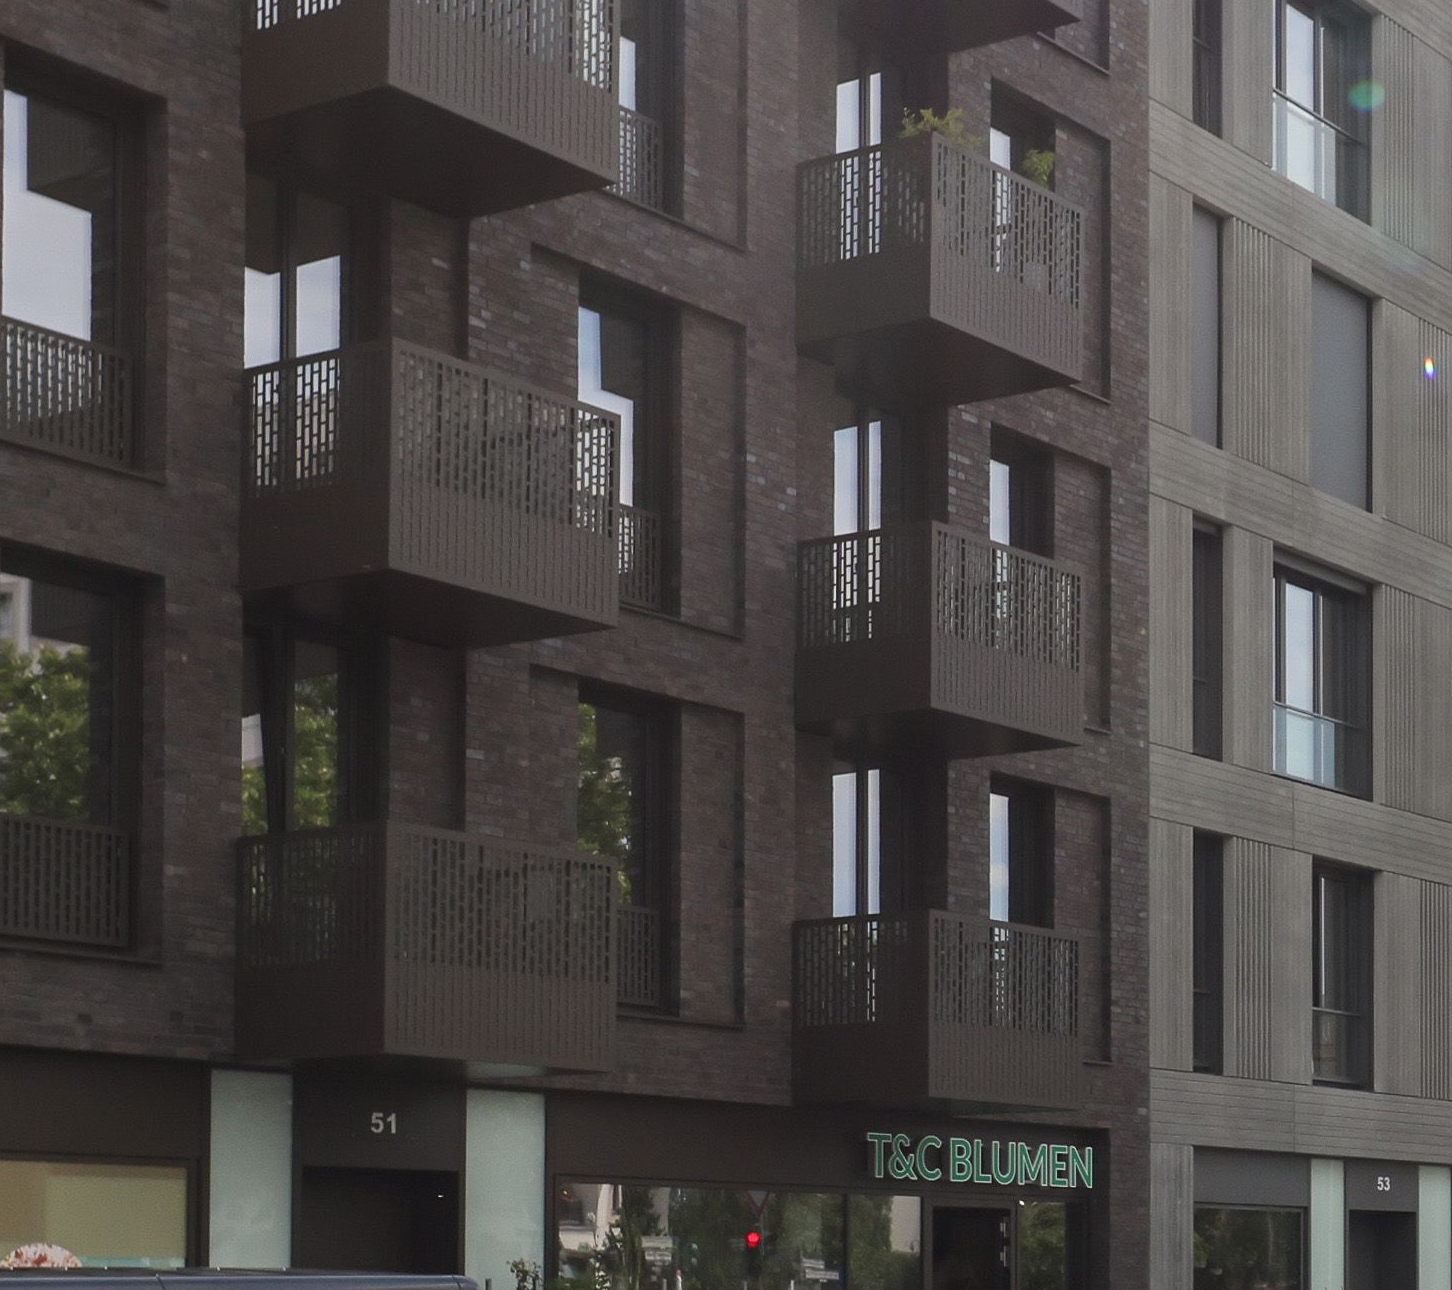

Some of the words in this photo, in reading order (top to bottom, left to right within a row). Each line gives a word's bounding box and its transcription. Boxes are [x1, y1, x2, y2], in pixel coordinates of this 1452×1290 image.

[370, 1112, 397, 1134] 51
[867, 1132, 942, 1182] T&C
[950, 1138, 1093, 1189] BLUMEN
[1377, 1176, 1391, 1191] 53
